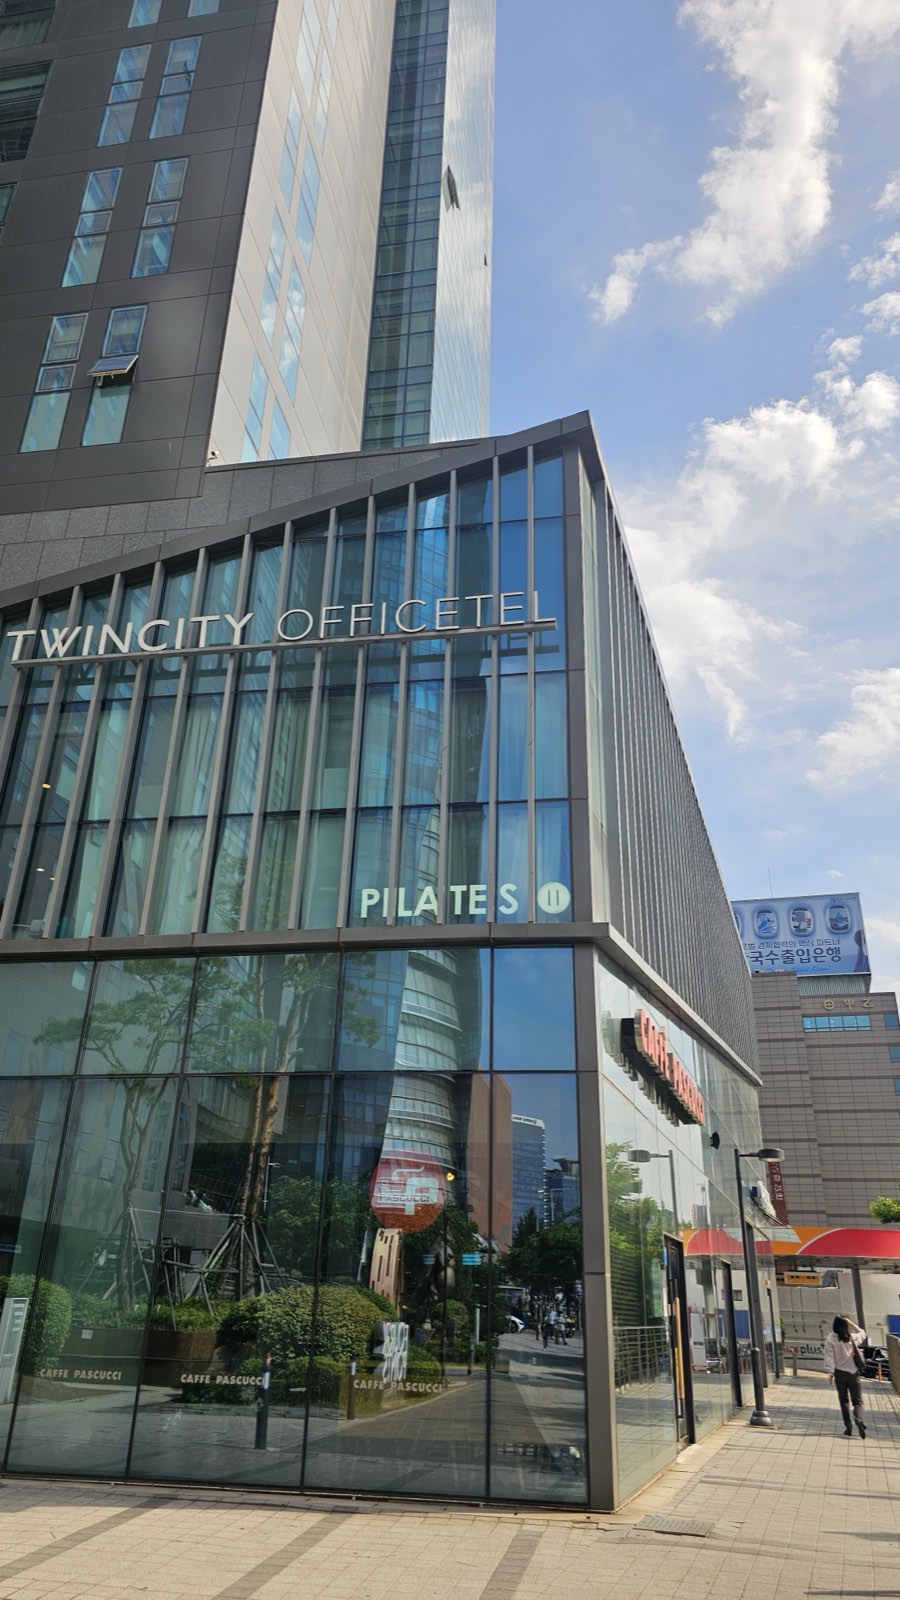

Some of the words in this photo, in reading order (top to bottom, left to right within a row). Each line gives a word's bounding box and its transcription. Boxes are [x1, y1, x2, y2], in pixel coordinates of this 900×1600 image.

[6, 612, 254, 662] TWINCITY
[276, 590, 557, 641] OFFICETEL
[360, 883, 518, 918] PILATES
[745, 947, 842, 965] 국수출입은행
[377, 1194, 431, 1203] PASCUCCI
[40, 1369, 69, 1378] CAFFE
[74, 1370, 122, 1381] PASCUCCI
[181, 1374, 211, 1384] CAFFE
[216, 1375, 266, 1386] PASCUCCI
[353, 1380, 384, 1390] CAFFE
[390, 1381, 443, 1393] PASCUCCI
